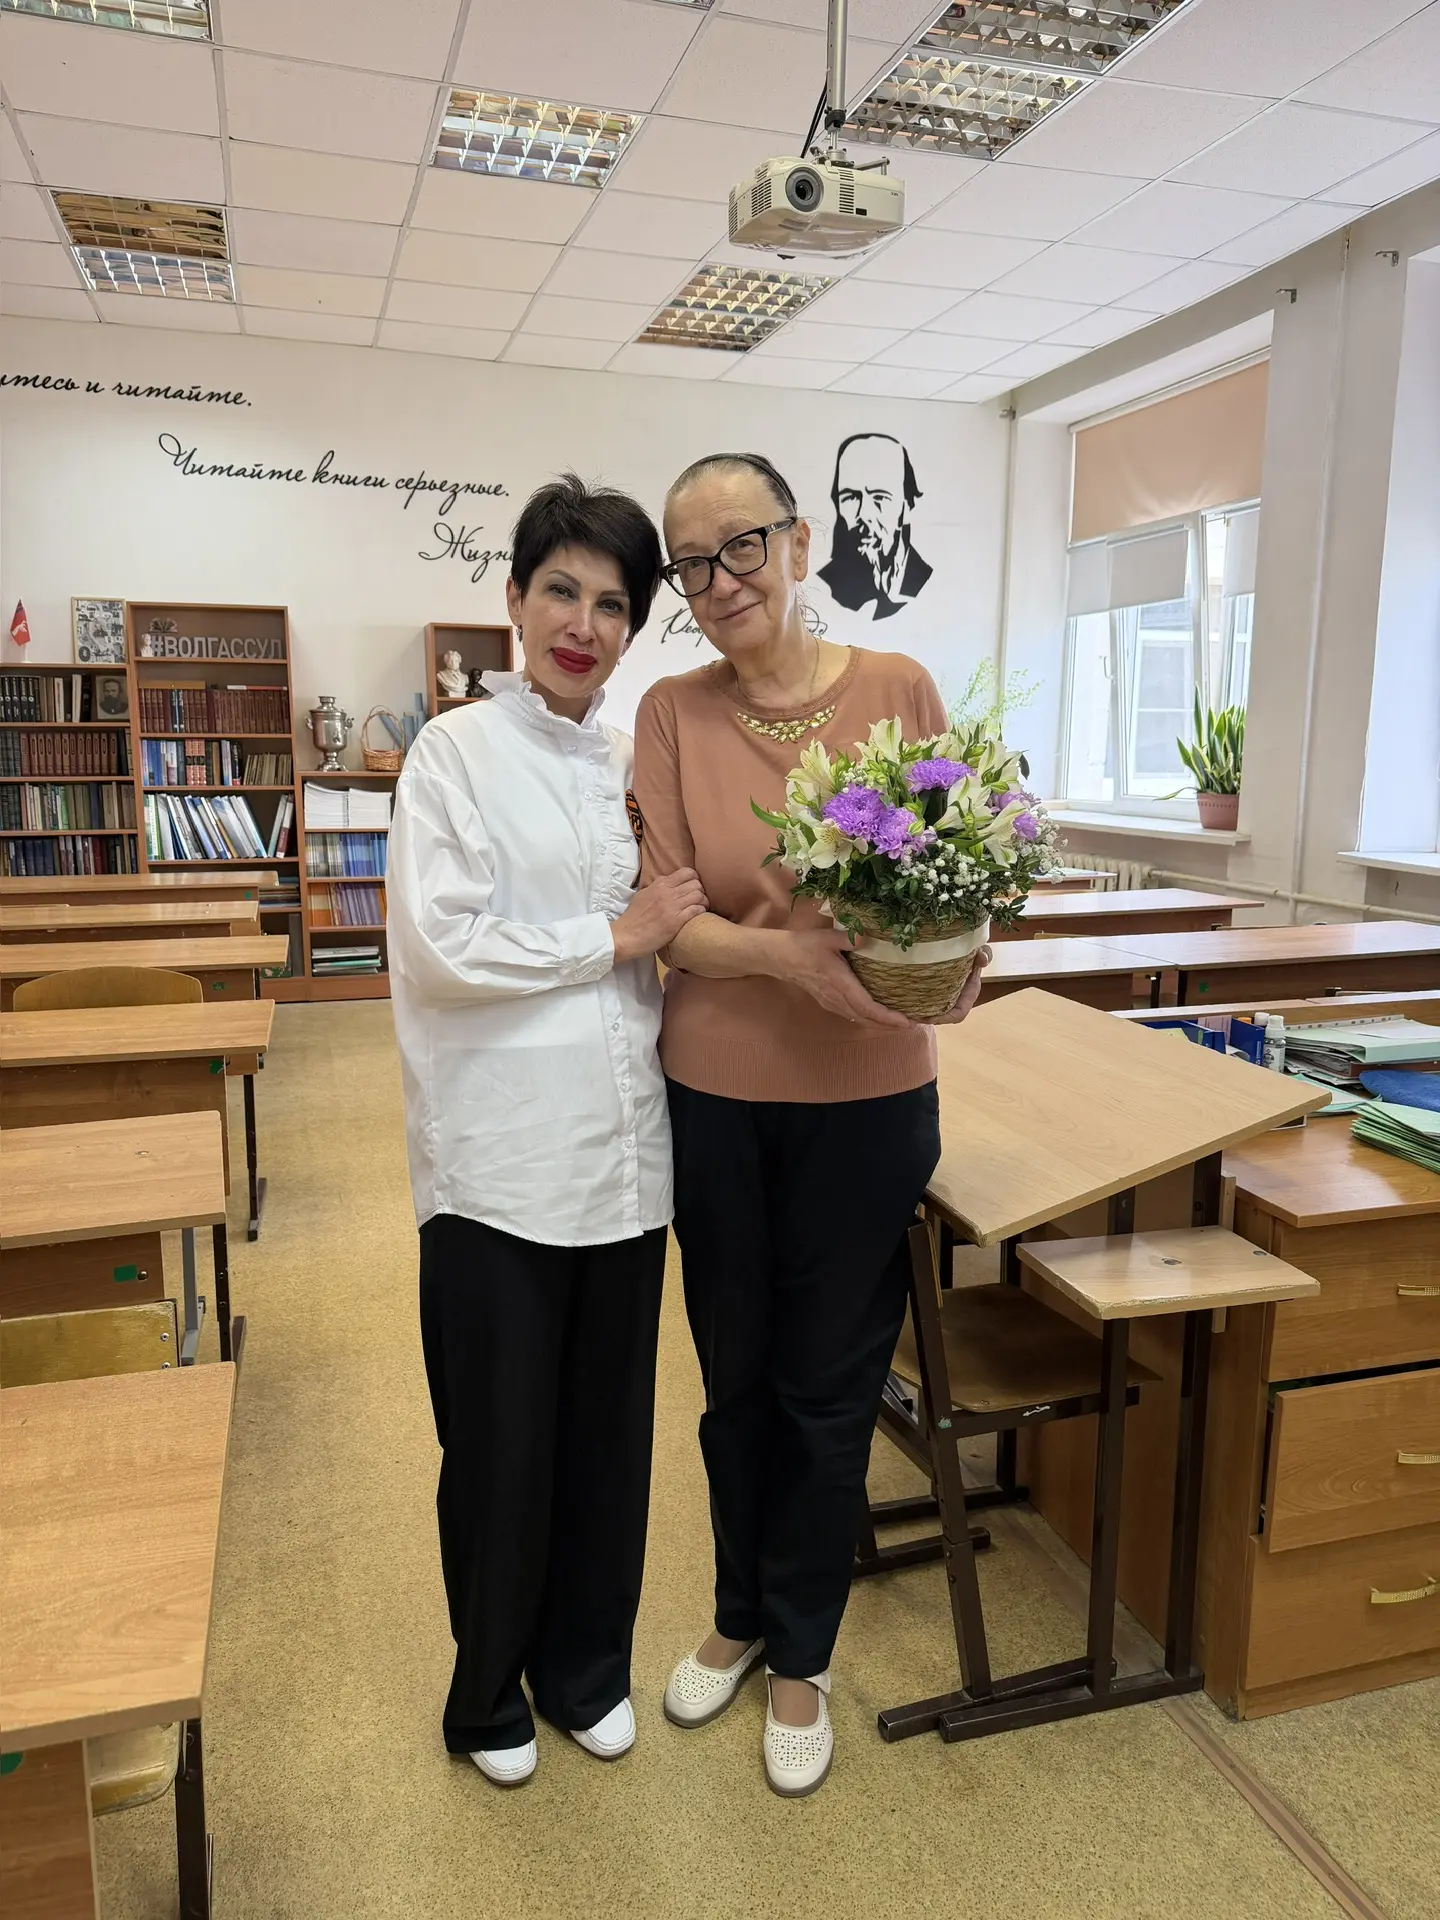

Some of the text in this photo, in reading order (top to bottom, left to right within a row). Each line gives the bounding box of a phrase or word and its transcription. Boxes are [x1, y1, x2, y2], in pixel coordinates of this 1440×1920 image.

[85, 380, 106, 394] и
[112, 382, 252, 408] читайте.
[158, 432, 510, 516] Читайте книги серьезные.
[418, 522, 513, 583] Жизн
